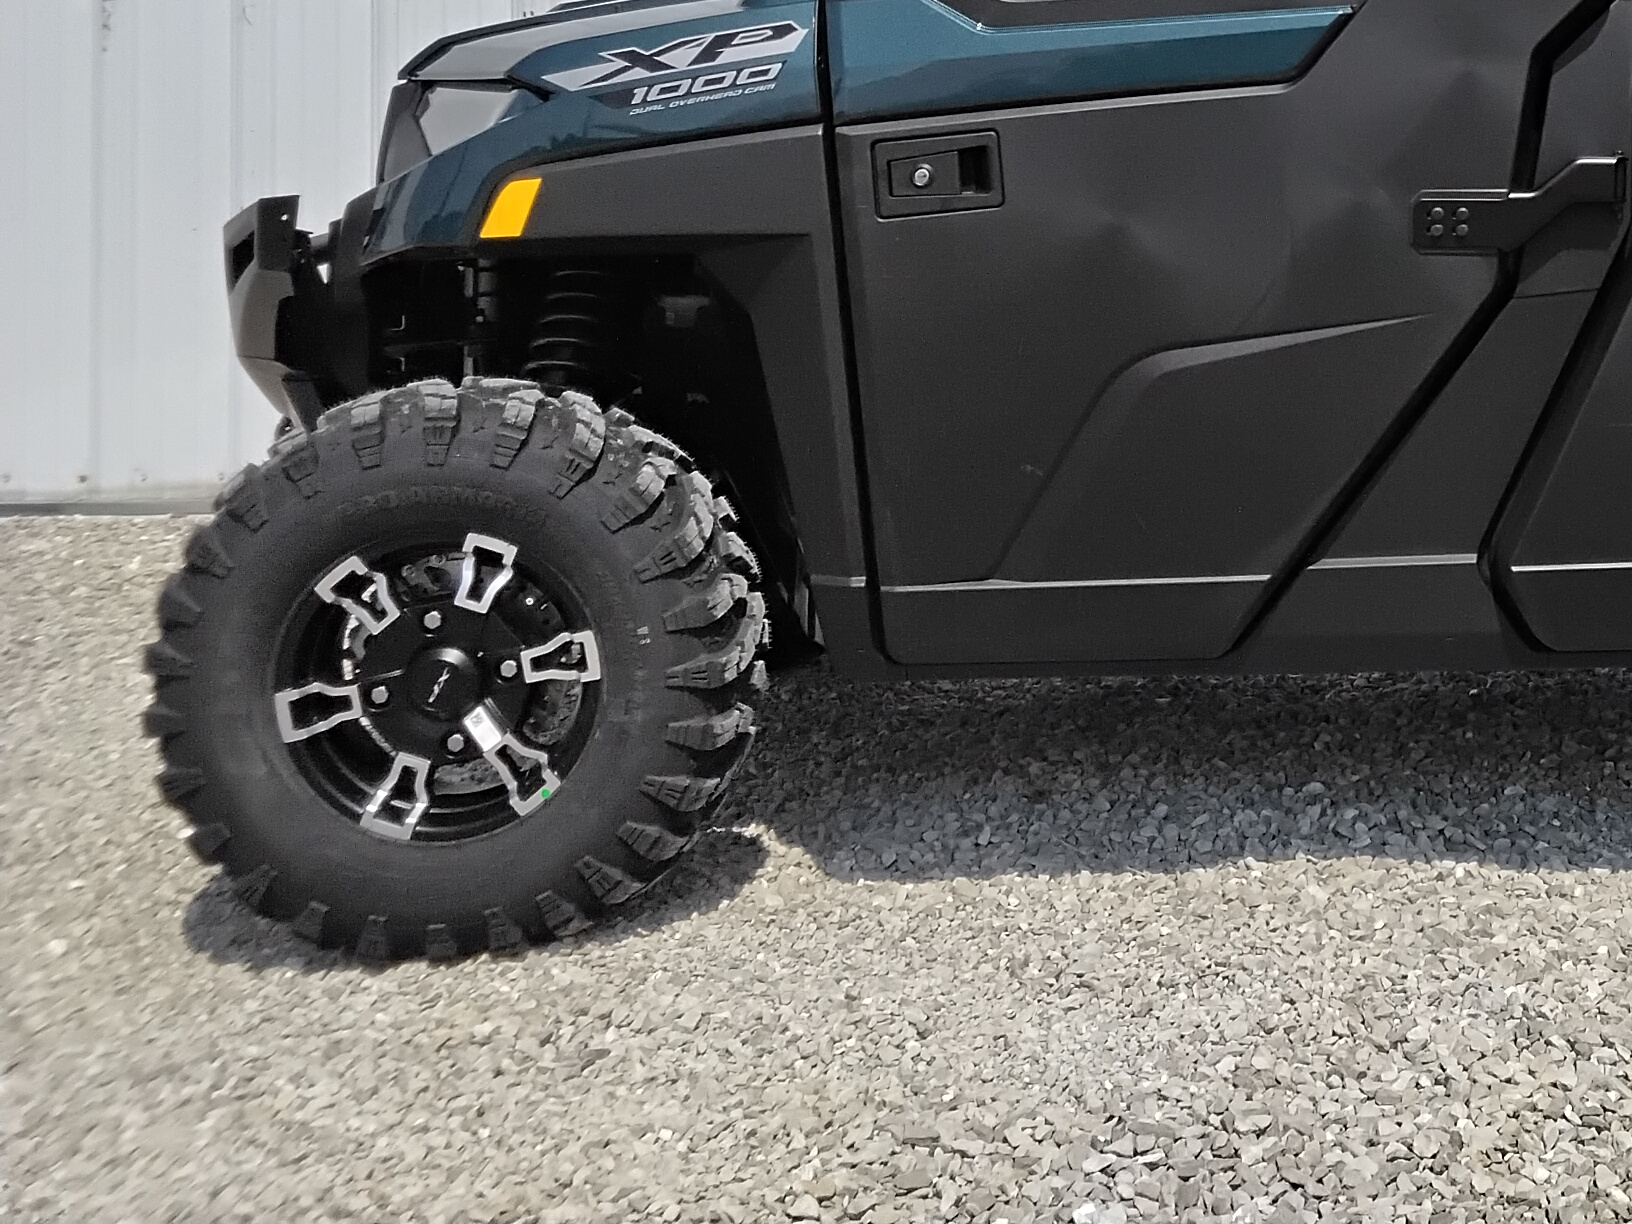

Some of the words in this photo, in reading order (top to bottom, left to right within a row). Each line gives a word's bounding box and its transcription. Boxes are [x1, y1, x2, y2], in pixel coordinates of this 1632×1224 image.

[572, 20, 803, 90] XP
[629, 103, 666, 116] DUAL
[668, 88, 743, 108] OVERHEAD
[744, 82, 777, 95] CAM
[630, 62, 783, 105] 1000
